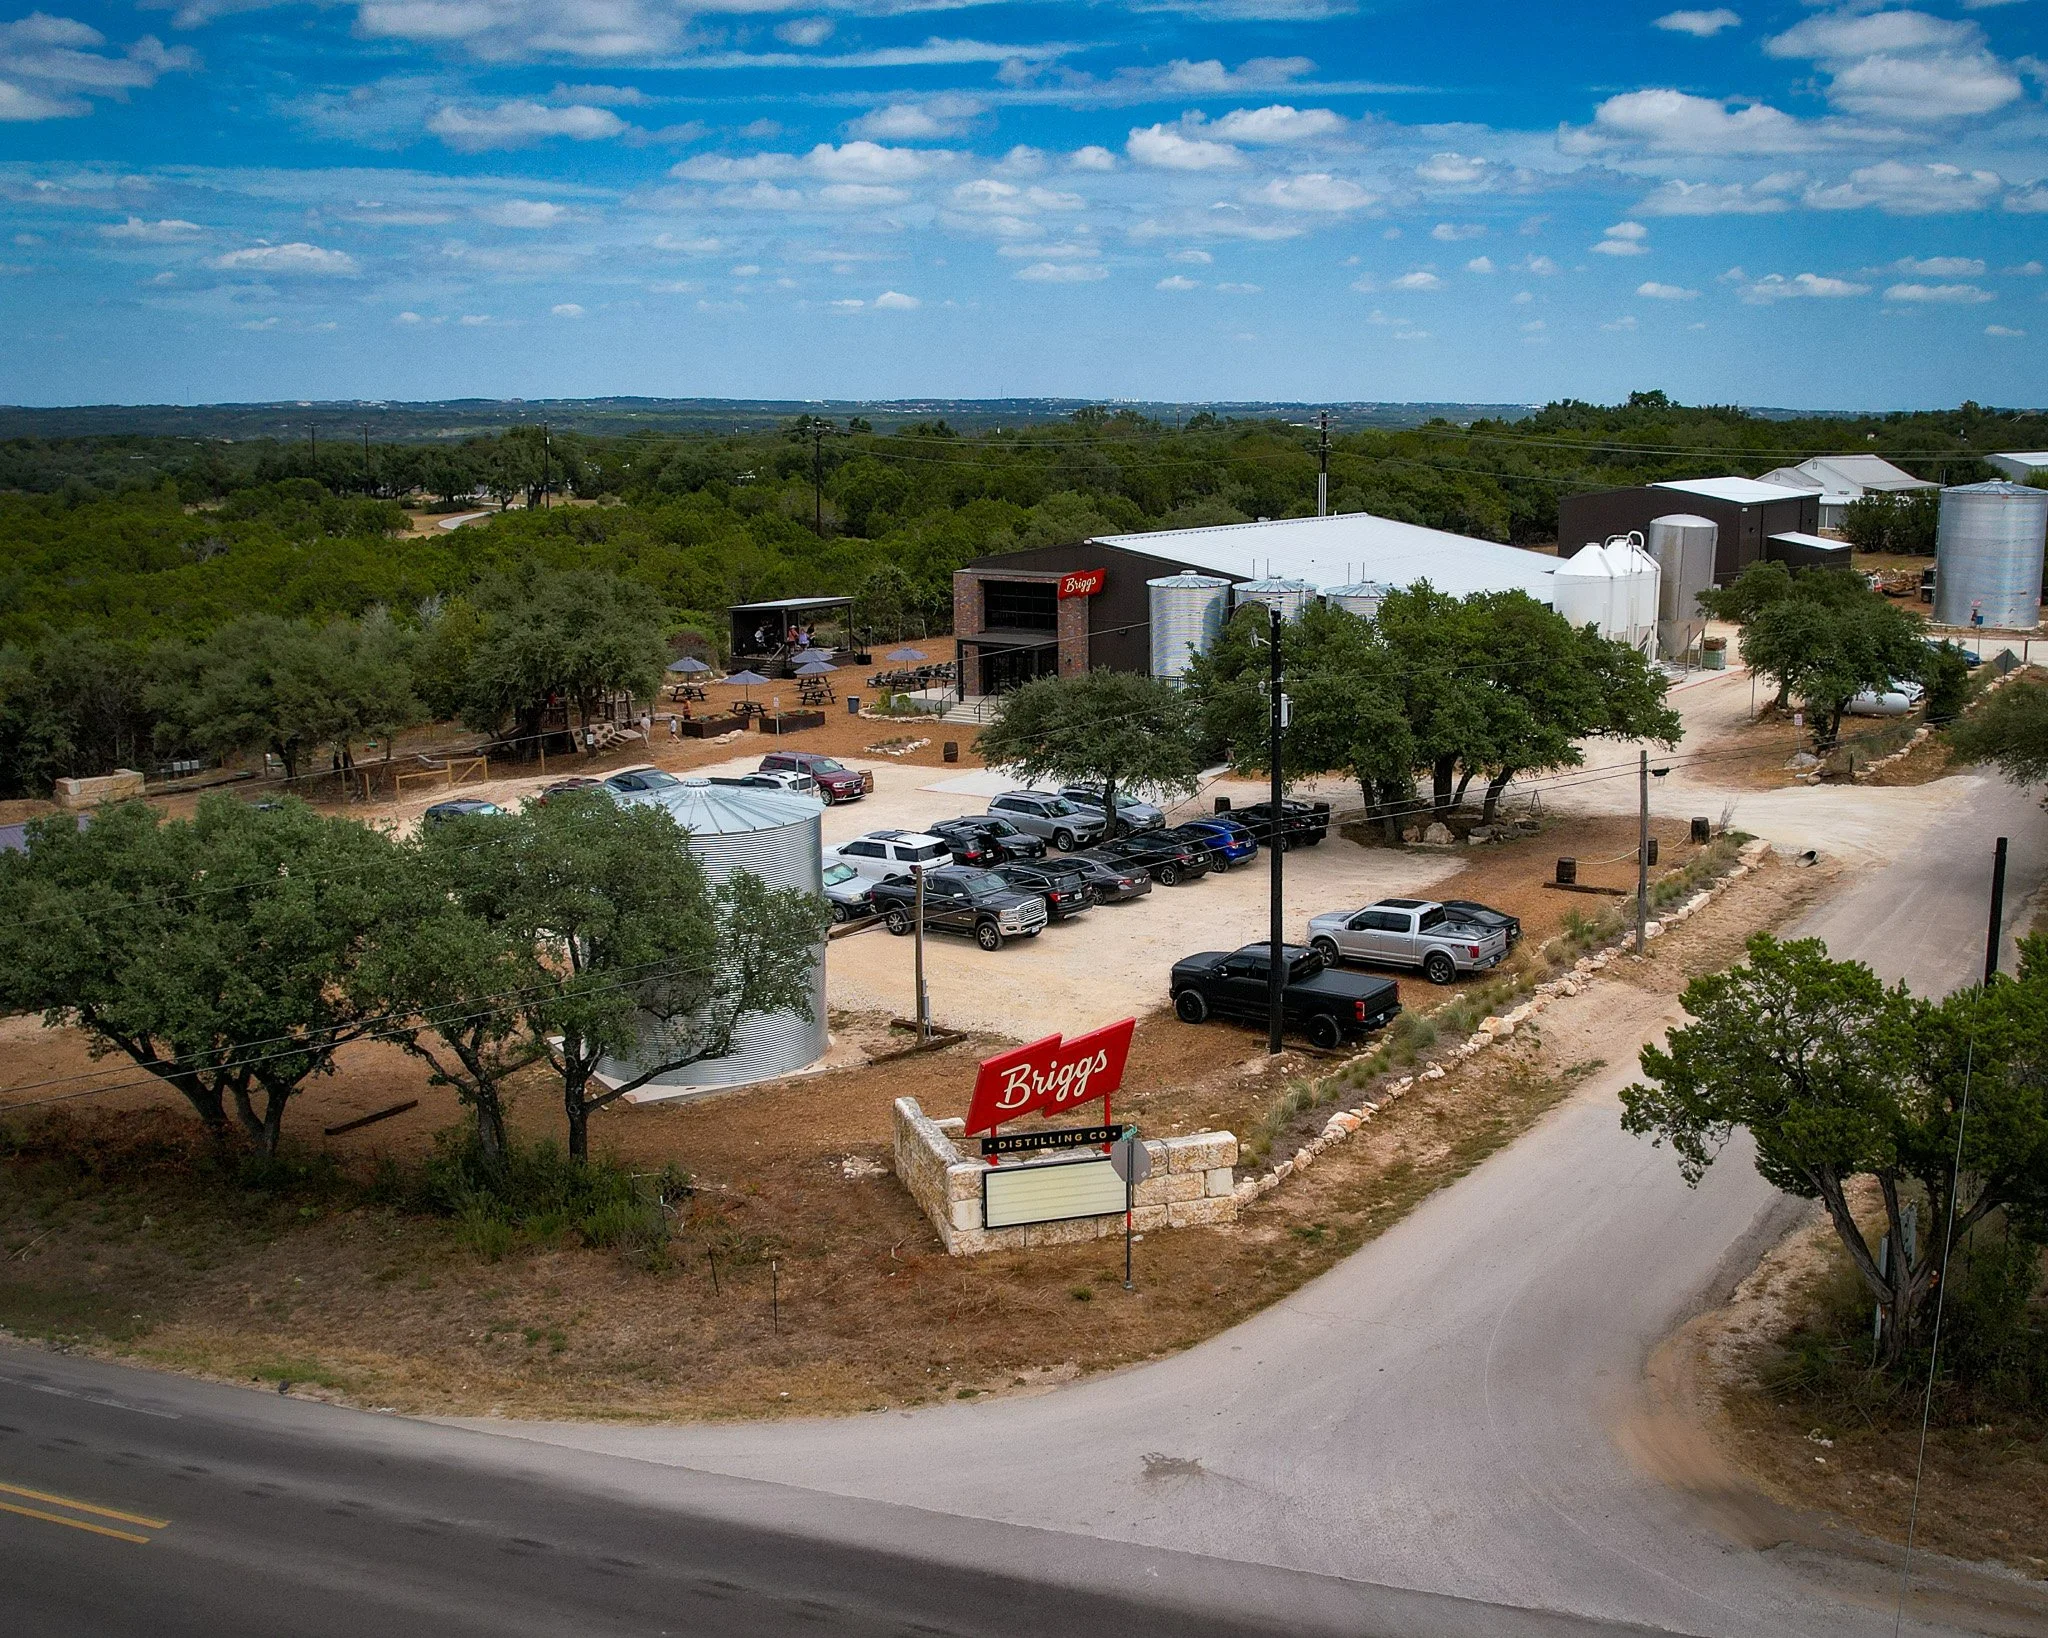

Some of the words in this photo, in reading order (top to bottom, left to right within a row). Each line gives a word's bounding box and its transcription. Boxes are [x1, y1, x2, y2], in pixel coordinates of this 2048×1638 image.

[1064, 576, 1097, 593] Briggs
[995, 1048, 1108, 1109] Briggs
[998, 1133, 1083, 1150] DISTILLING
